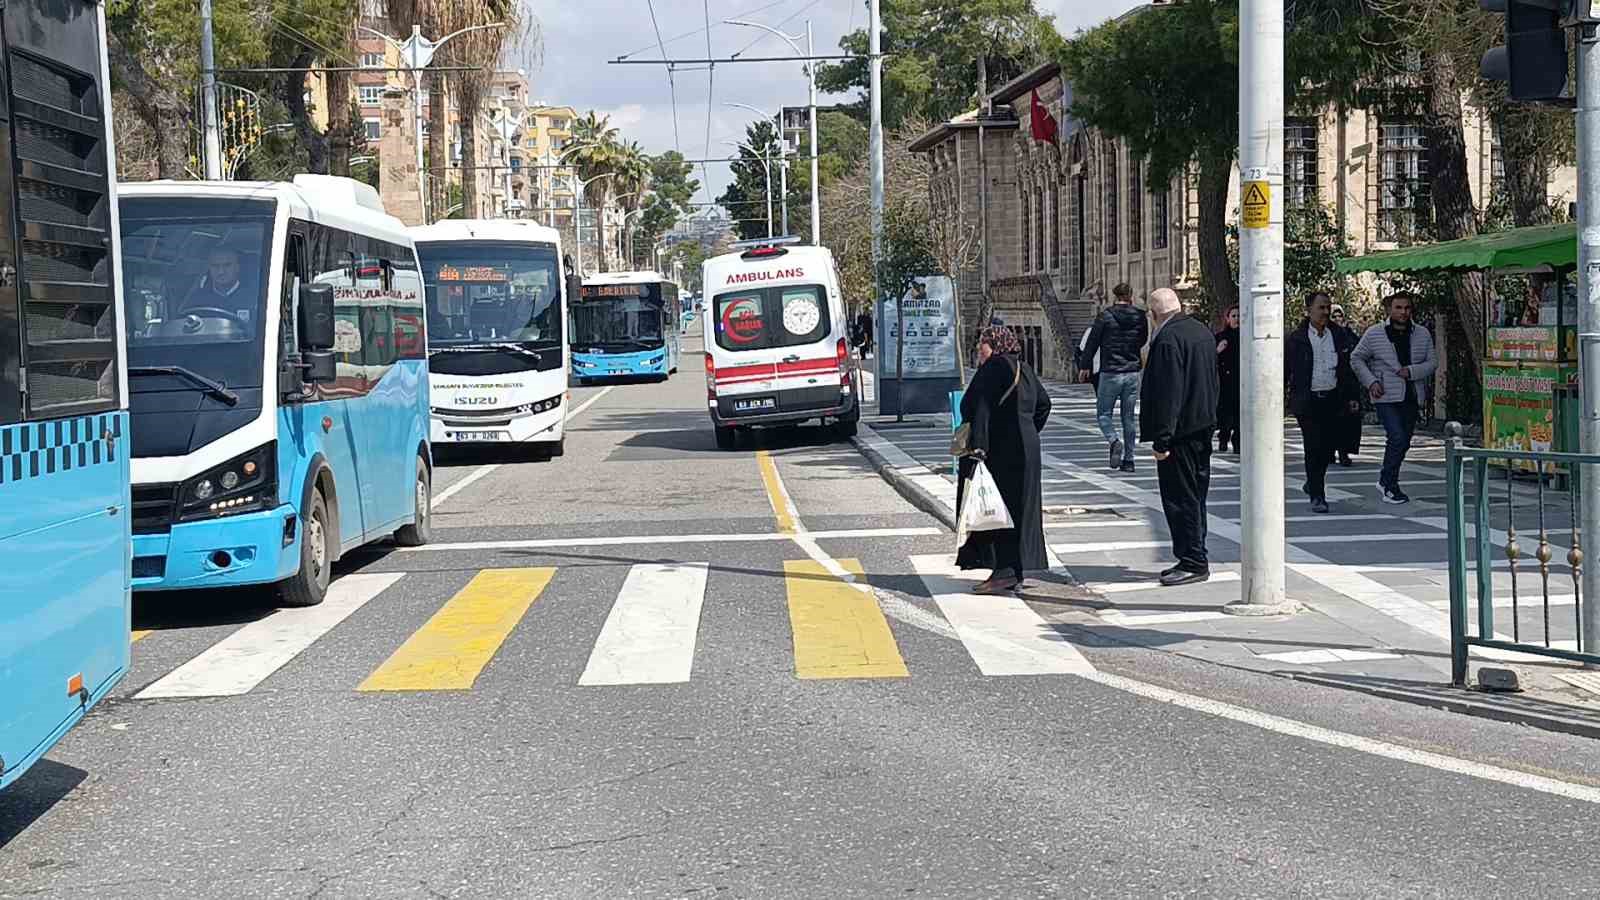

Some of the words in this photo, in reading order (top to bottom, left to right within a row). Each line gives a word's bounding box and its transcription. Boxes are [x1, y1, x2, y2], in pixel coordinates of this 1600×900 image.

[1249, 169, 1262, 179] 73
[726, 267, 805, 284] AMBULANS
[454, 396, 498, 405] ISUZU
